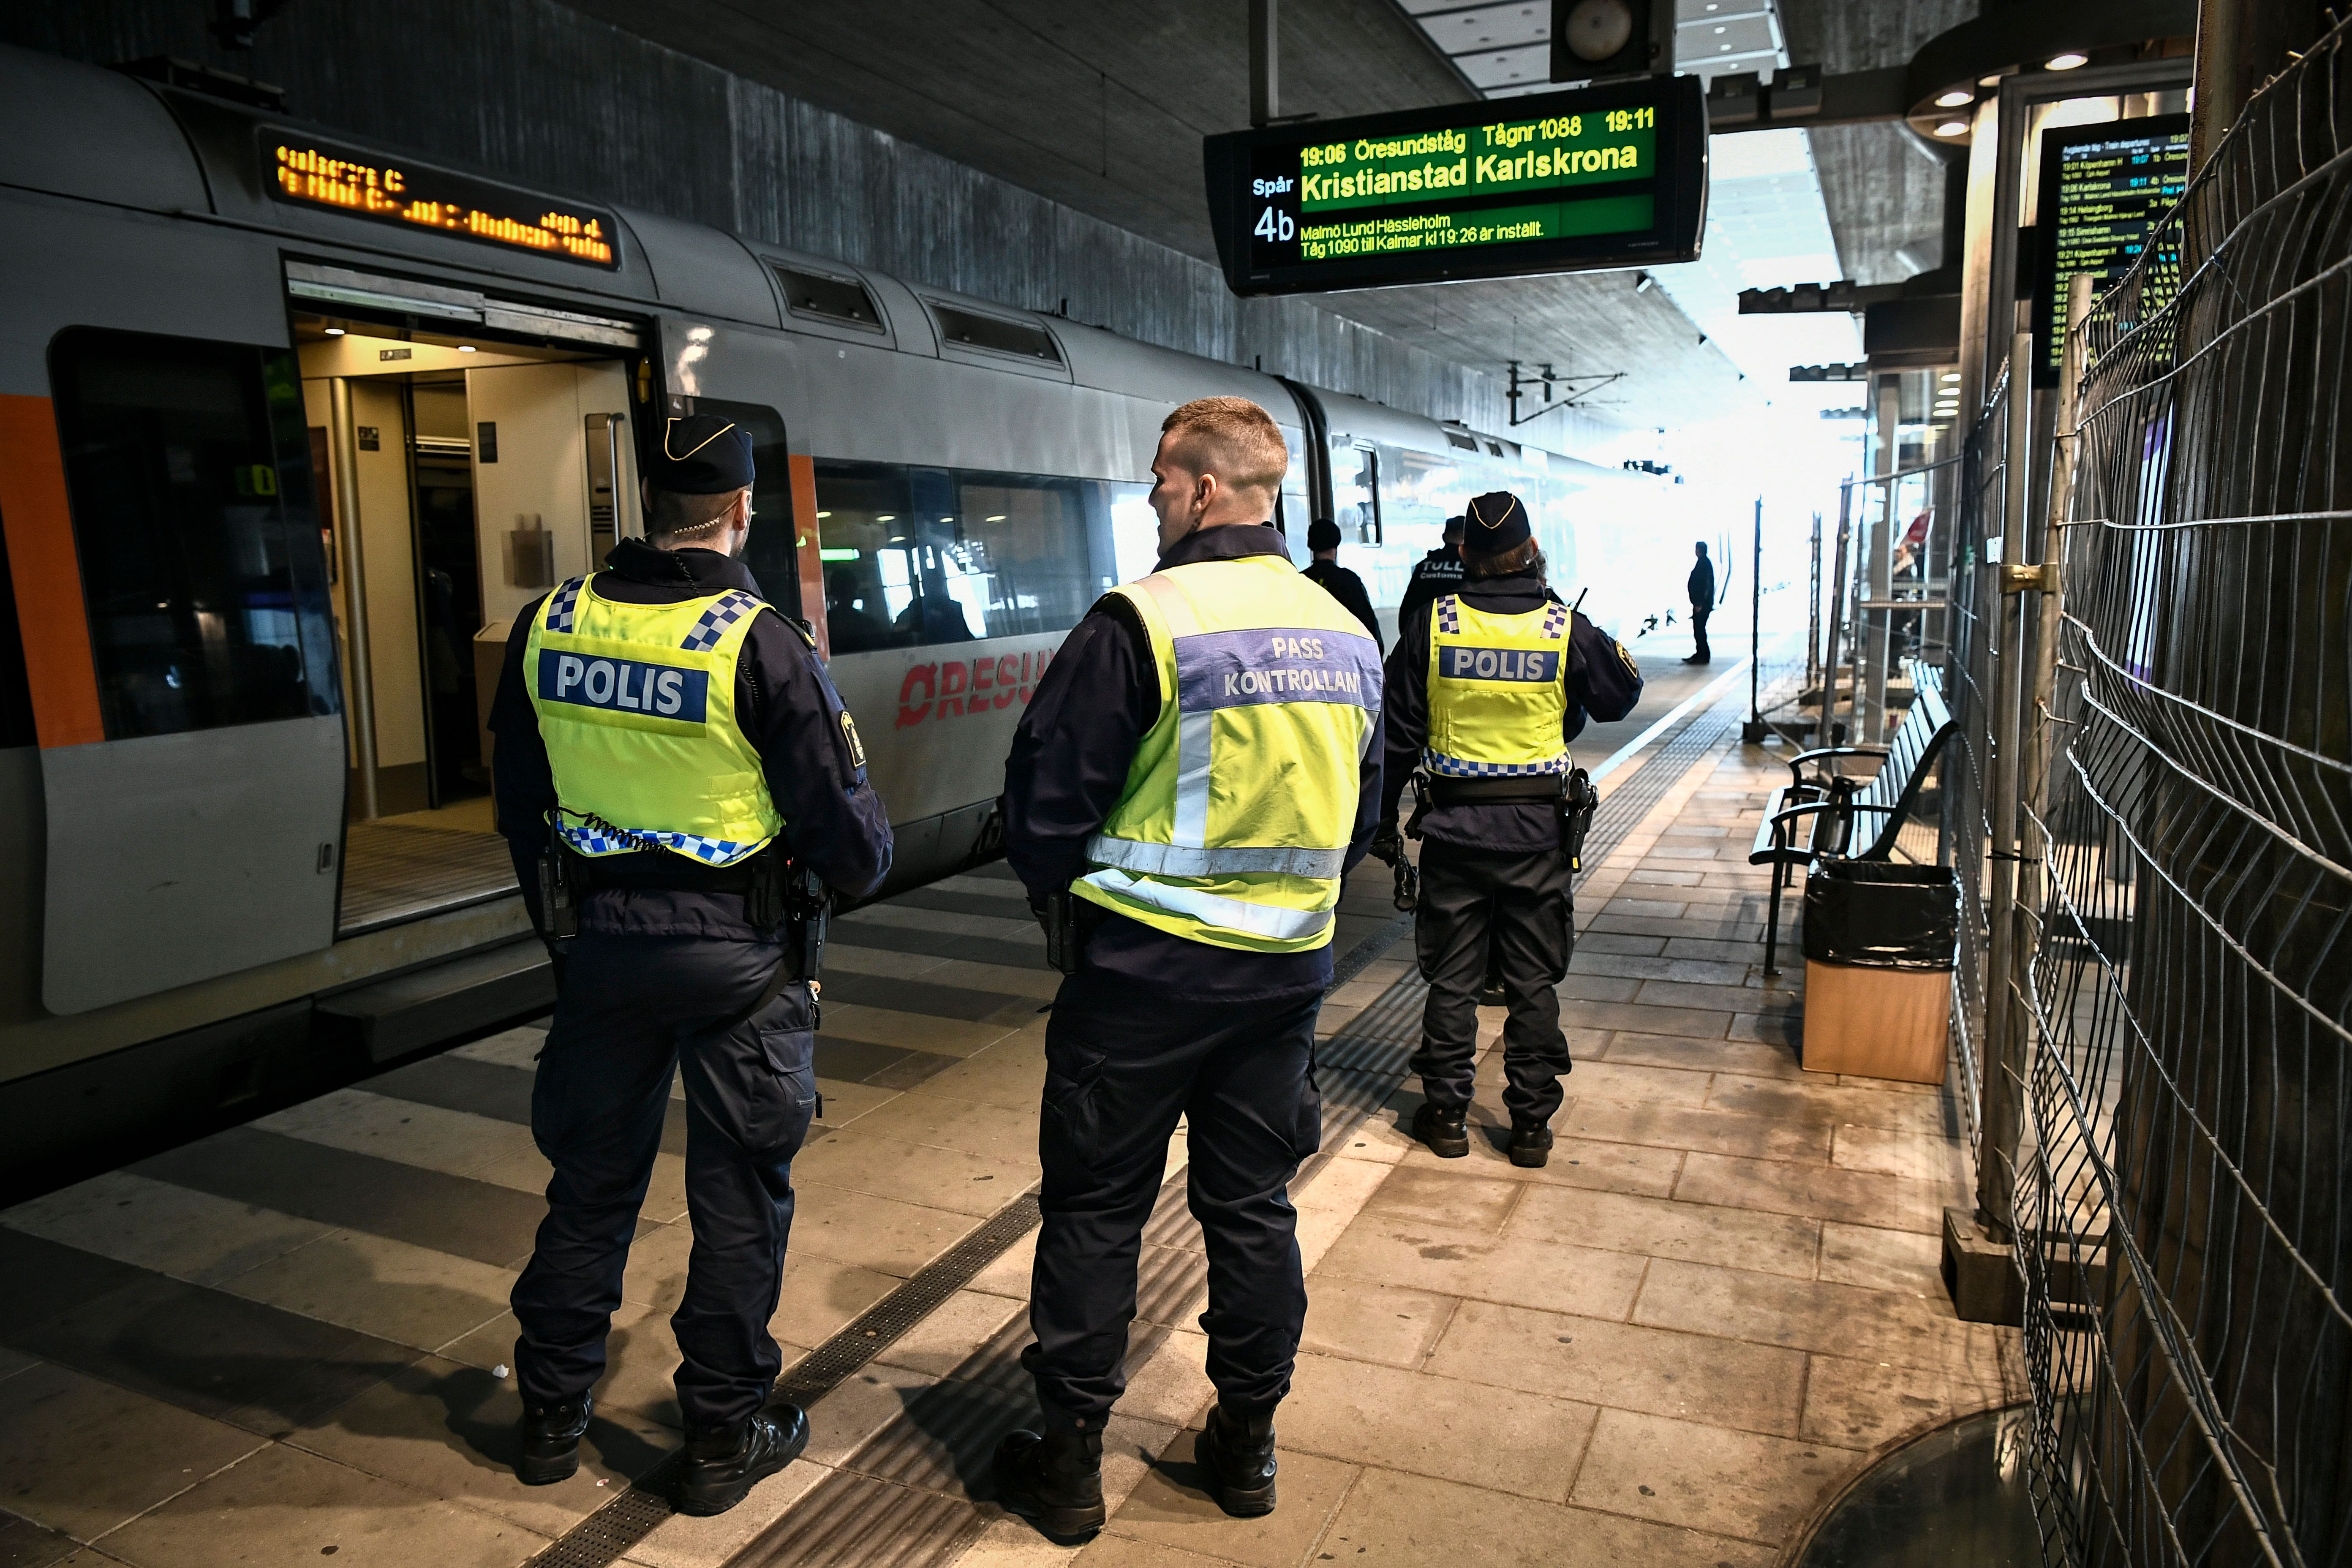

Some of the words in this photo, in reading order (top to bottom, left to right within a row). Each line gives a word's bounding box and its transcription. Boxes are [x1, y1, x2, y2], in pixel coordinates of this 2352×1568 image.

[1300, 144, 1346, 167] 19:06
[1354, 128, 1466, 161] Öresundståg
[1482, 122, 1536, 148] Tågnr
[1538, 115, 1582, 140] 1088
[1605, 107, 1654, 132] 19:11
[1253, 175, 1294, 198] Spår
[1301, 158, 1467, 202] Kristianstad
[1476, 145, 1638, 184] Karlskrona
[1254, 206, 1294, 242] 4b
[1300, 224, 1341, 241] Malmö
[1343, 220, 1375, 237] Lund
[1376, 214, 1451, 234] Hässleholm
[1300, 241, 1326, 259] Tåg
[1328, 238, 1359, 255] 1090
[1361, 237, 1375, 252] till
[1376, 234, 1423, 250] Kalmar
[1425, 230, 1437, 246] kl
[1479, 226, 1494, 241] är
[1496, 220, 1544, 240] inställt.
[1424, 561, 1464, 572] TULL
[1271, 637, 1323, 660] PASS
[1453, 648, 1544, 681] POLIS
[556, 655, 683, 714] POLIS
[895, 648, 1056, 731] ØRESU
[1225, 669, 1360, 696] KONTROLLAN
